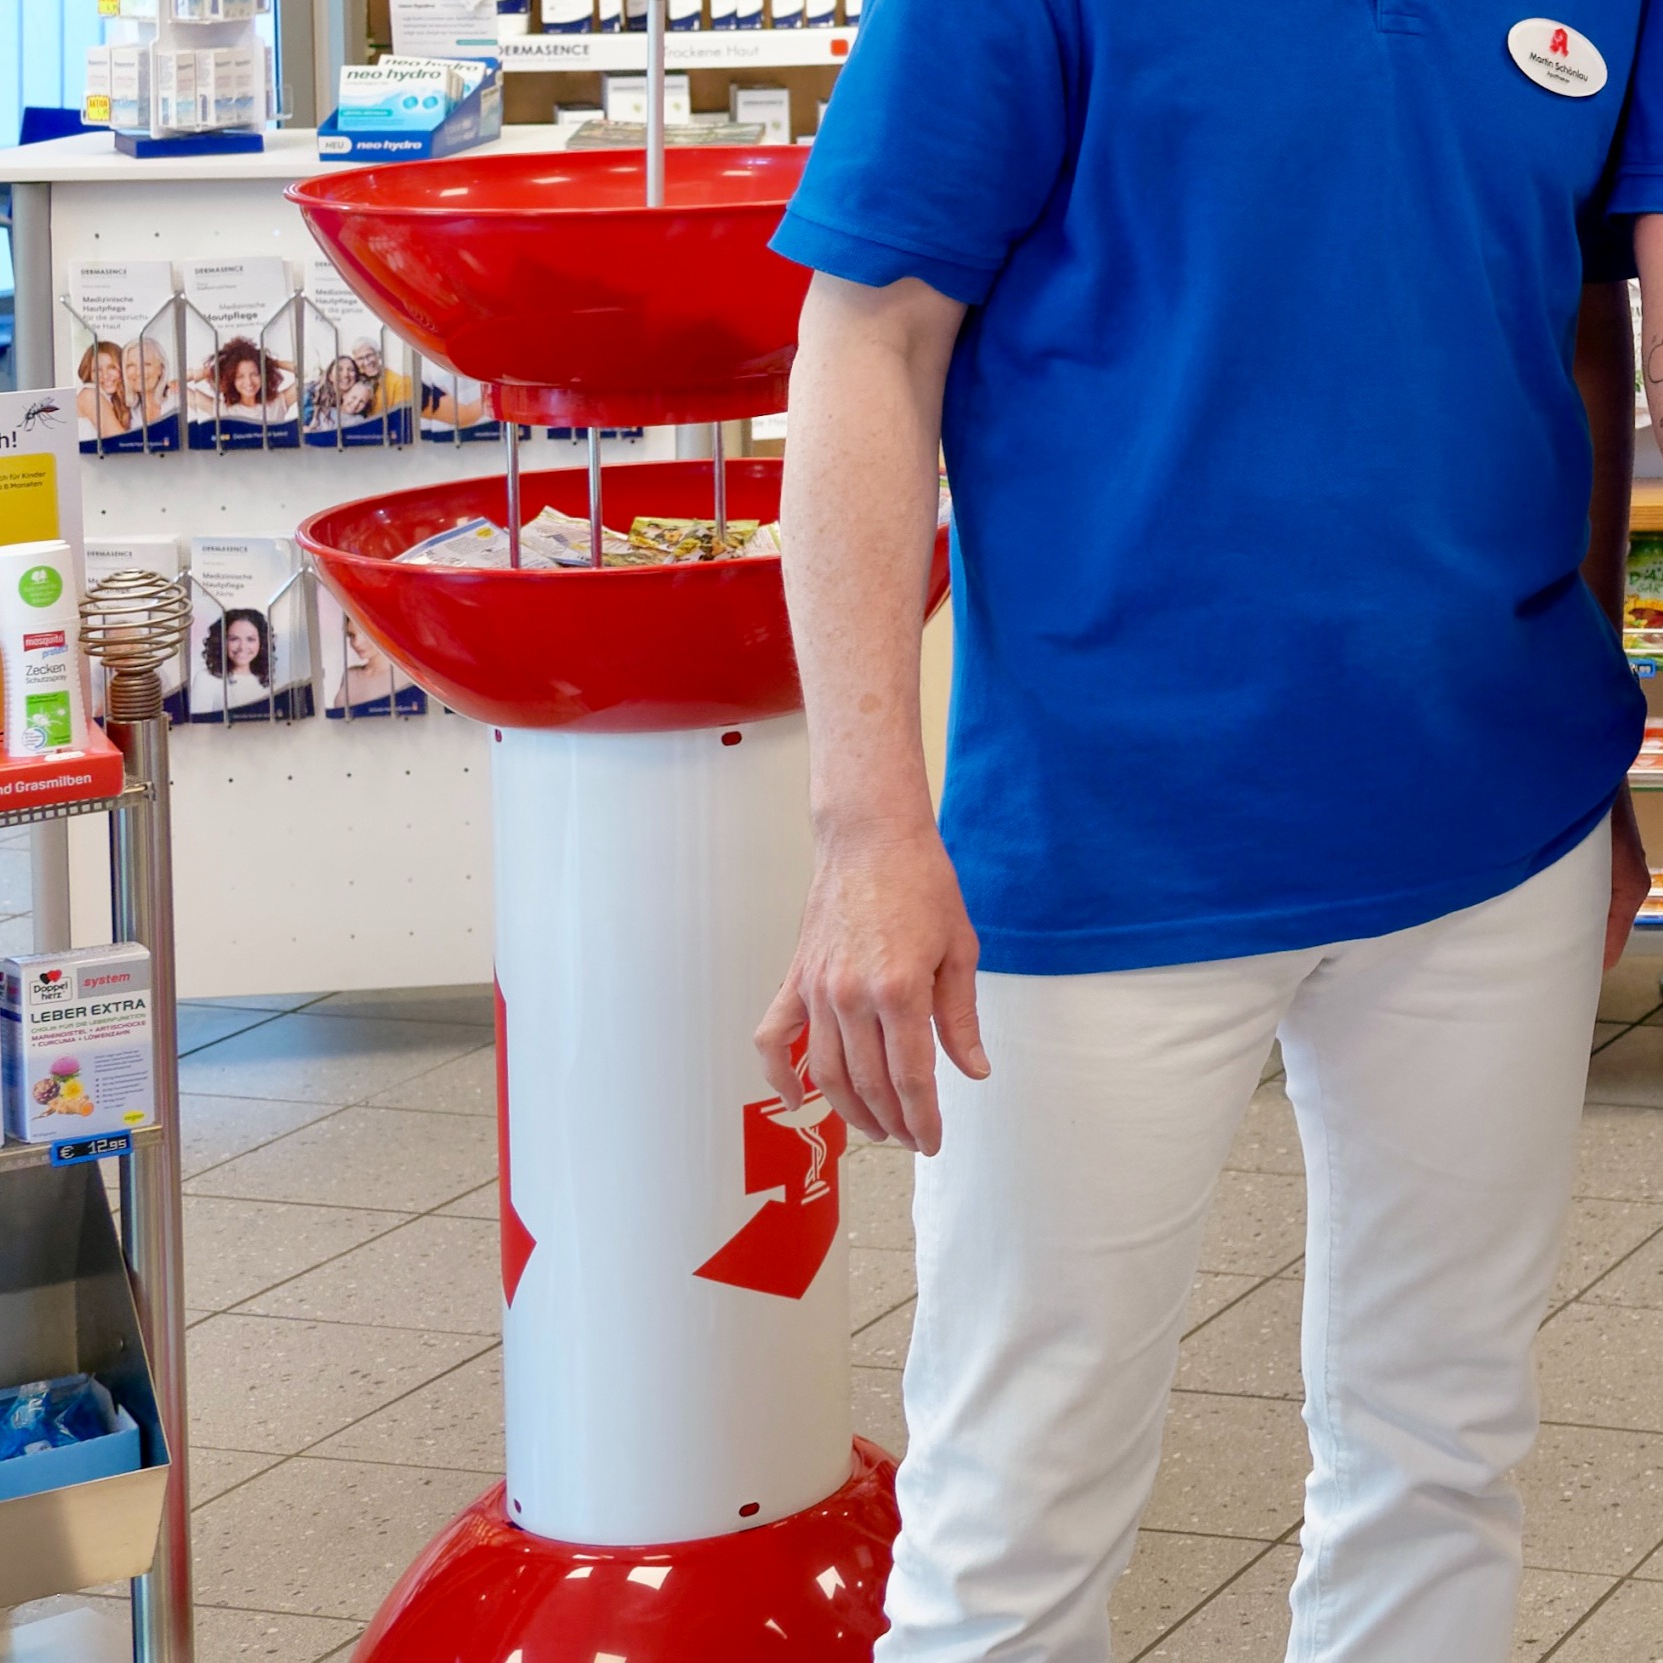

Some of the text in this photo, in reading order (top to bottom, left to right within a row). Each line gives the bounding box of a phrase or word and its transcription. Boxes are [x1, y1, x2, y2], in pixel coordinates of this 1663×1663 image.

[26, 662, 66, 677] Zecken
[15, 773, 92, 794] Grasmilben
[83, 972, 130, 988] system
[34, 981, 68, 996] Doppel
[41, 989, 62, 1001] herz
[30, 998, 147, 1025] LEBER EXTRA
